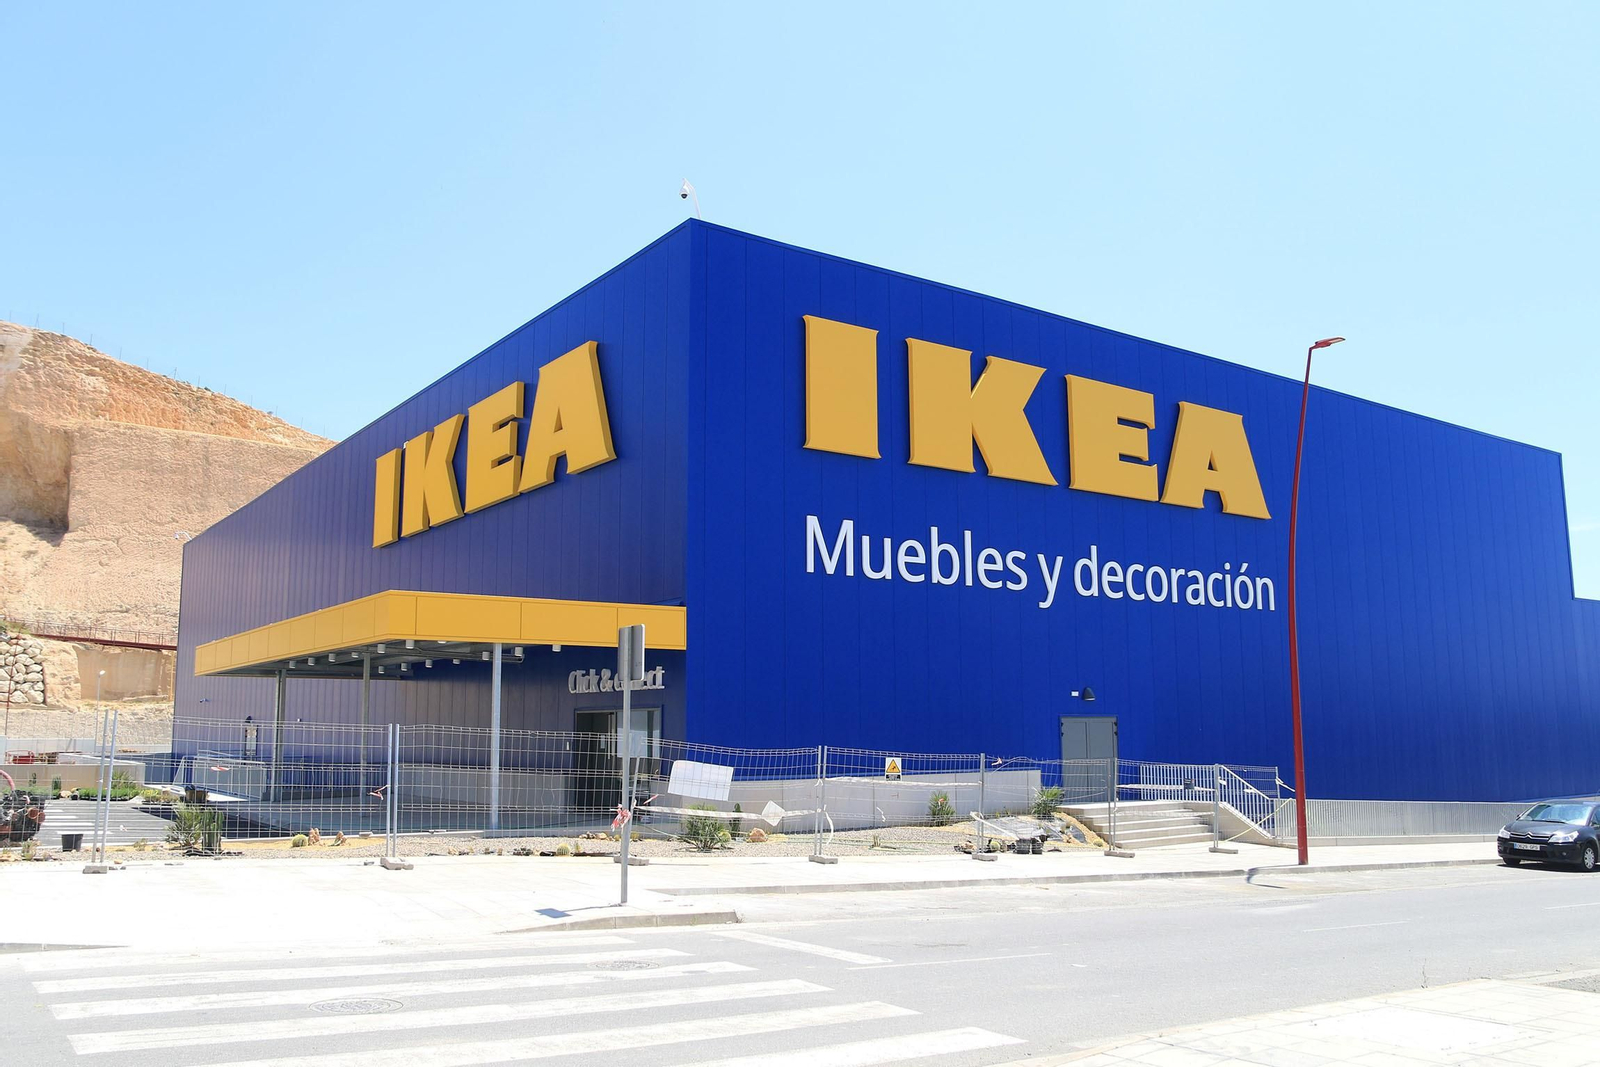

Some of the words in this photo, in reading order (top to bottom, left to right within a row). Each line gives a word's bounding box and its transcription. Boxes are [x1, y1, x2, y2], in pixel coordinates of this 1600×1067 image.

[372, 340, 617, 549] IKEA
[803, 314, 1271, 520] IKEA
[806, 515, 1028, 592] Muebles
[1037, 553, 1064, 609] y
[1074, 544, 1277, 612] decoración
[568, 668, 600, 694] Click
[600, 668, 614, 692] &
[614, 666, 665, 692] cect
